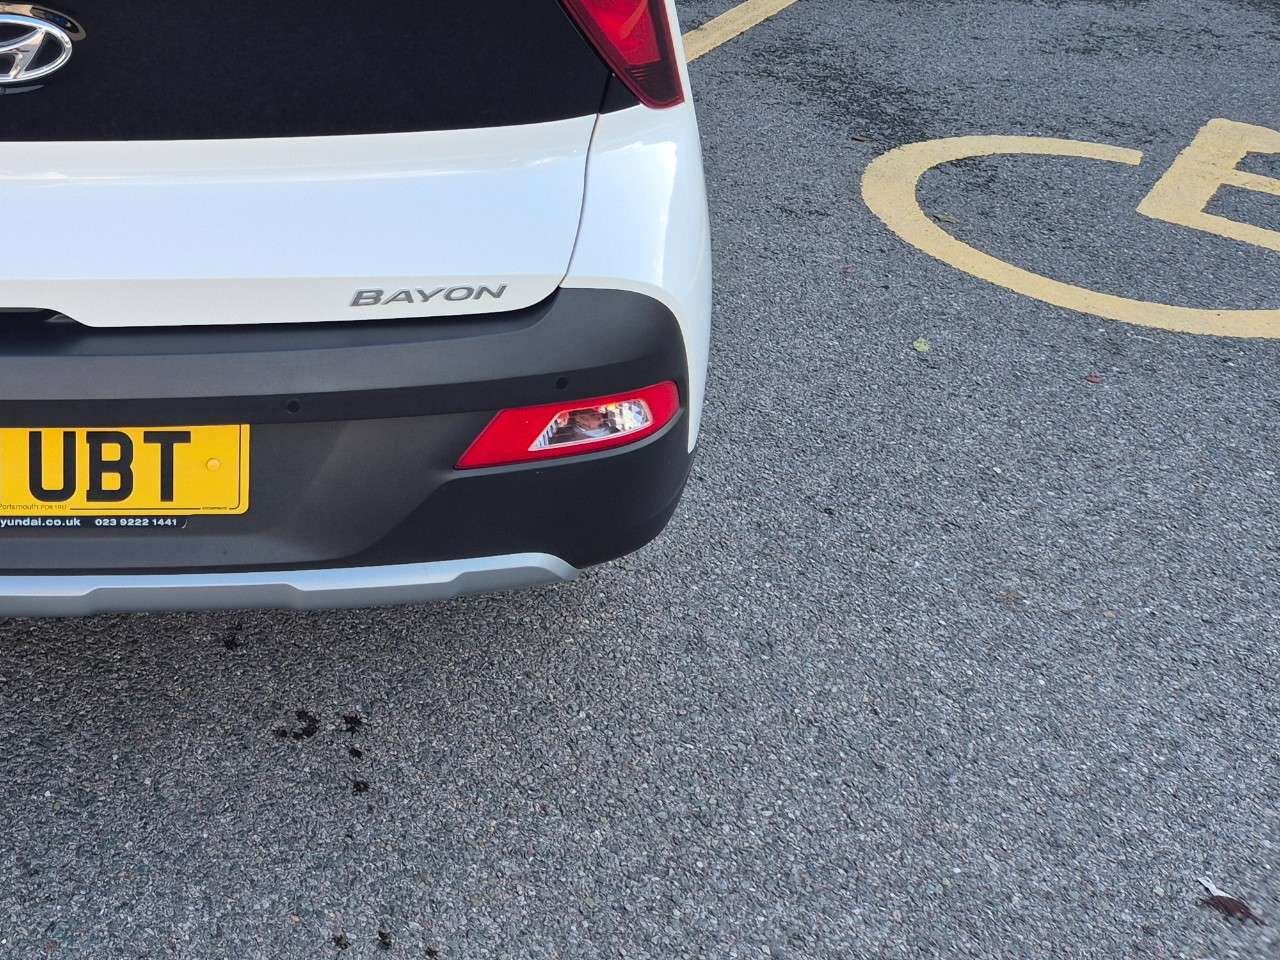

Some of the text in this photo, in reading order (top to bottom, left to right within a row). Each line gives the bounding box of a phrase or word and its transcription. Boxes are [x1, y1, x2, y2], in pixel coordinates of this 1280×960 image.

[350, 285, 508, 307] BAYON
[28, 429, 191, 503] UBT
[95, 518, 117, 527] 023
[120, 518, 149, 527] 9222
[152, 518, 177, 527] 1441
